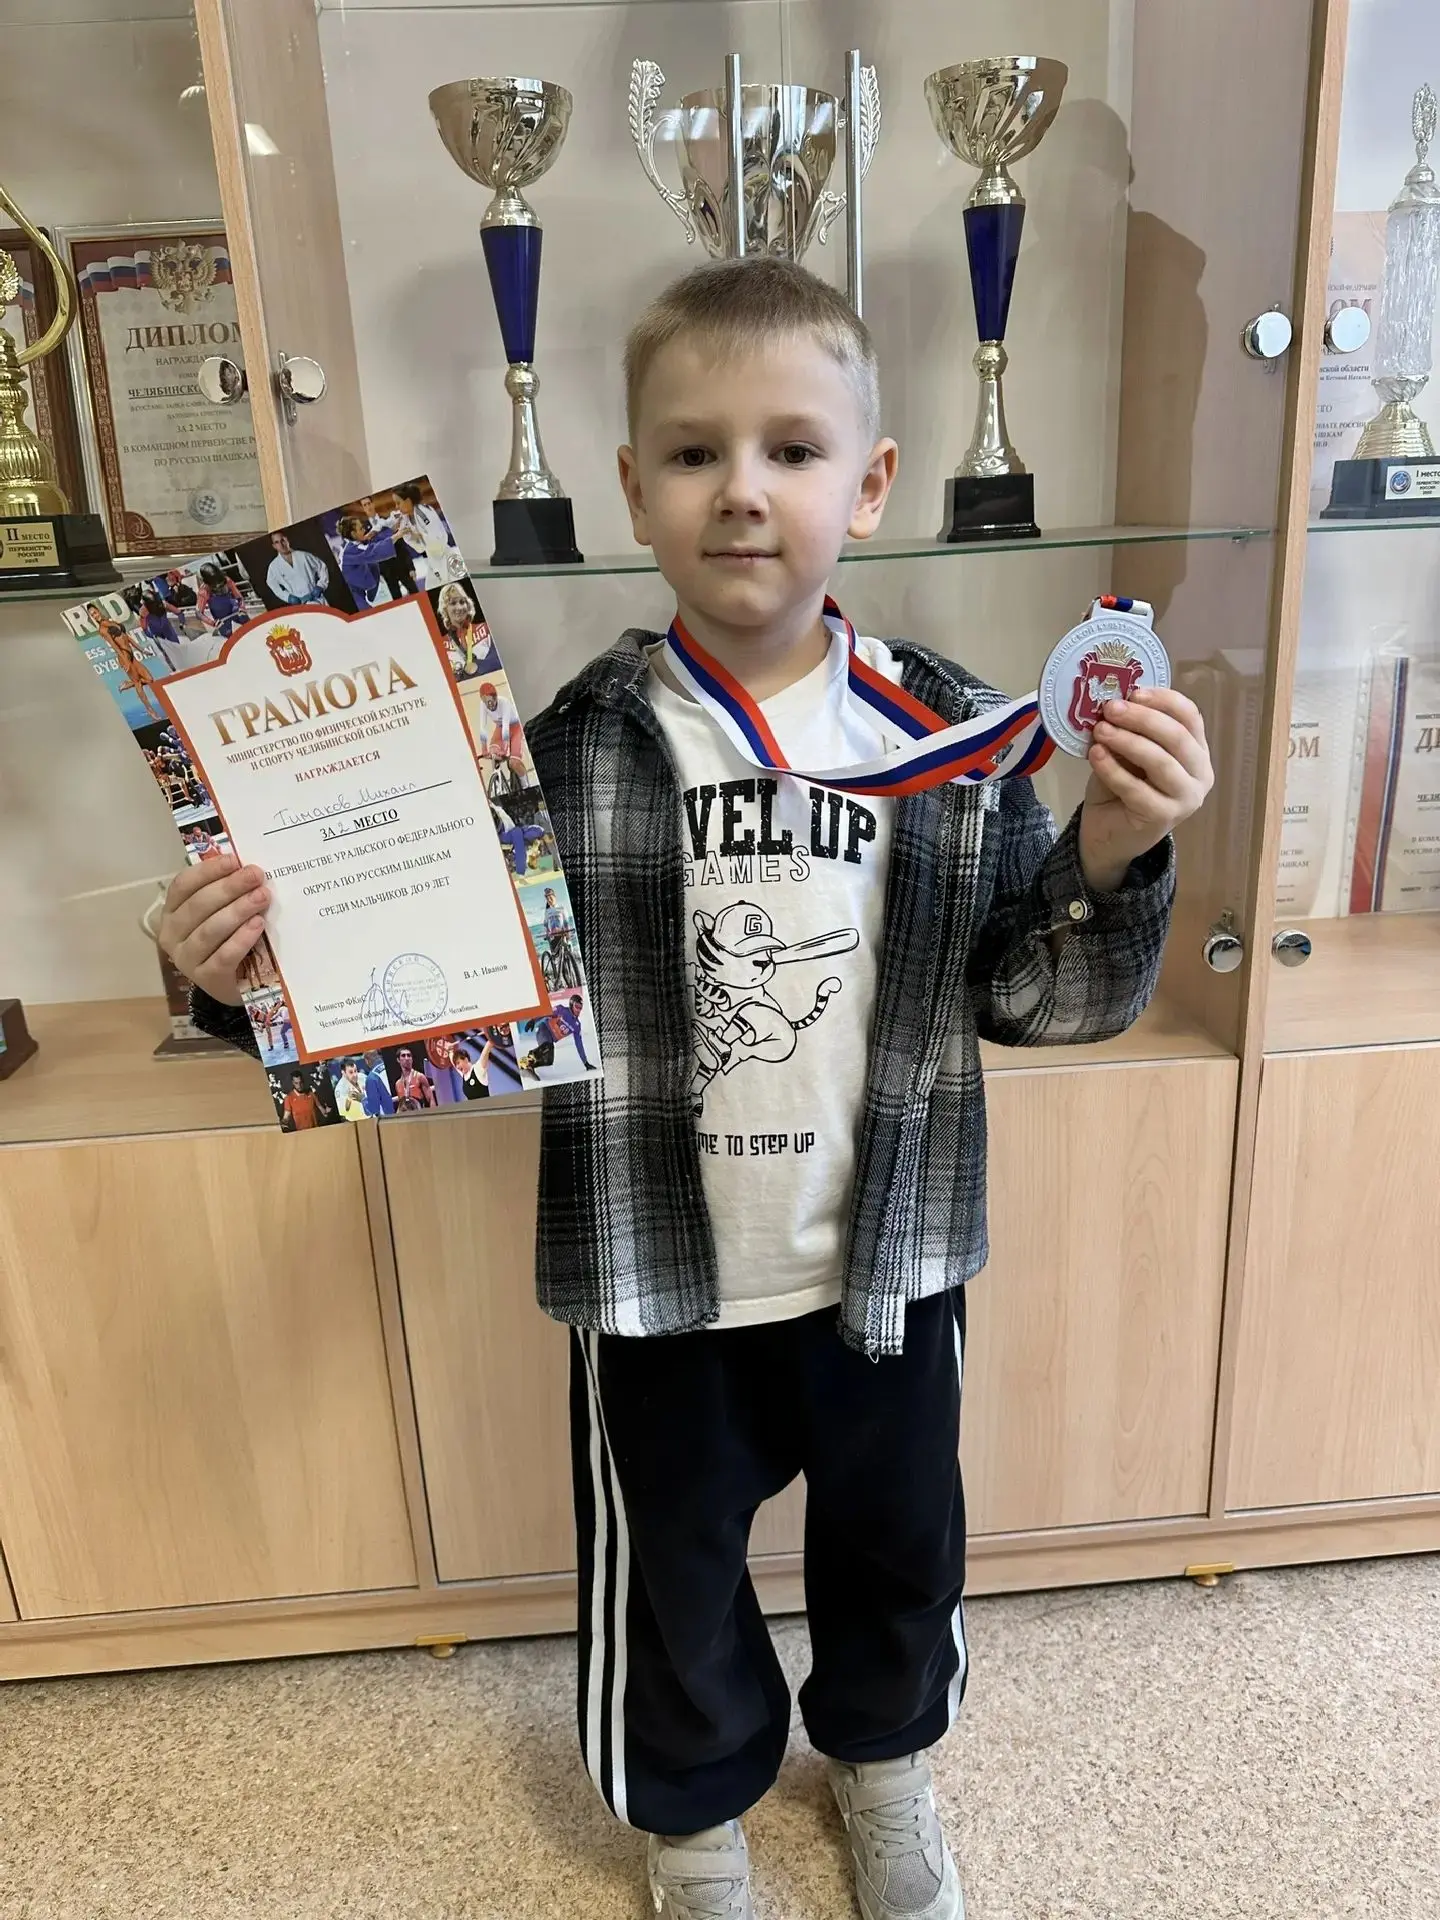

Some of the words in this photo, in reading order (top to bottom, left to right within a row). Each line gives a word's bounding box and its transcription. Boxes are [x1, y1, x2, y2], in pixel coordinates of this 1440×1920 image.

[131, 441, 190, 453] КОМАНДНОМ
[191, 437, 248, 448] ПЕРВЕНСТВЕ
[189, 424, 194, 432] 2
[195, 422, 227, 431] МЕСТО
[154, 458, 168, 467] ПО
[169, 456, 213, 466] РУССКИМ
[213, 452, 257, 462] ШАШКАМ
[208, 656, 418, 747] ГРАМОТА
[226, 735, 299, 765] МИНИСТЕРСТВО
[299, 731, 314, 744] ПО
[314, 708, 377, 738] ФИЗИЧЕСКОЙ
[379, 697, 427, 721] КУЛЬТУРЕ
[250, 760, 258, 771] И
[258, 750, 294, 769] СПОРТУ
[295, 728, 366, 757] ЧЕЛЯБИНСКОЙ
[366, 715, 411, 738] ОБЛАСТИ
[294, 750, 381, 783] НАГРАЖДАЕТСЯ
[273, 794, 351, 827] Тимаков
[357, 782, 416, 806] Михаил
[319, 827, 337, 839] ЗА
[353, 808, 399, 830] МЕСТО
[809, 787, 877, 864] UP
[265, 871, 273, 881] В
[274, 854, 333, 878] ПЕРВЕНСТВЕ
[334, 838, 396, 863] УРАЛЬСКОГО
[397, 816, 475, 845] ФЕДЕРАЛЬНОГО
[682, 845, 811, 887] GAMES
[303, 879, 341, 897] ОКРУГА
[341, 875, 355, 887] ПО
[355, 862, 402, 883] РУССКИМ
[402, 849, 452, 870] ШАШКАМ
[318, 902, 349, 918] СРЕДИ
[350, 886, 409, 910] МАЛЬЧИКОВ
[410, 884, 424, 897] ДО
[424, 882, 431, 891] 9
[432, 876, 451, 888] ЛЕТ
[744, 914, 762, 936] G
[481, 964, 508, 976] Иванов
[725, 1135, 743, 1156] TO
[750, 1133, 788, 1156] STEP
[794, 1132, 815, 1154] UP
